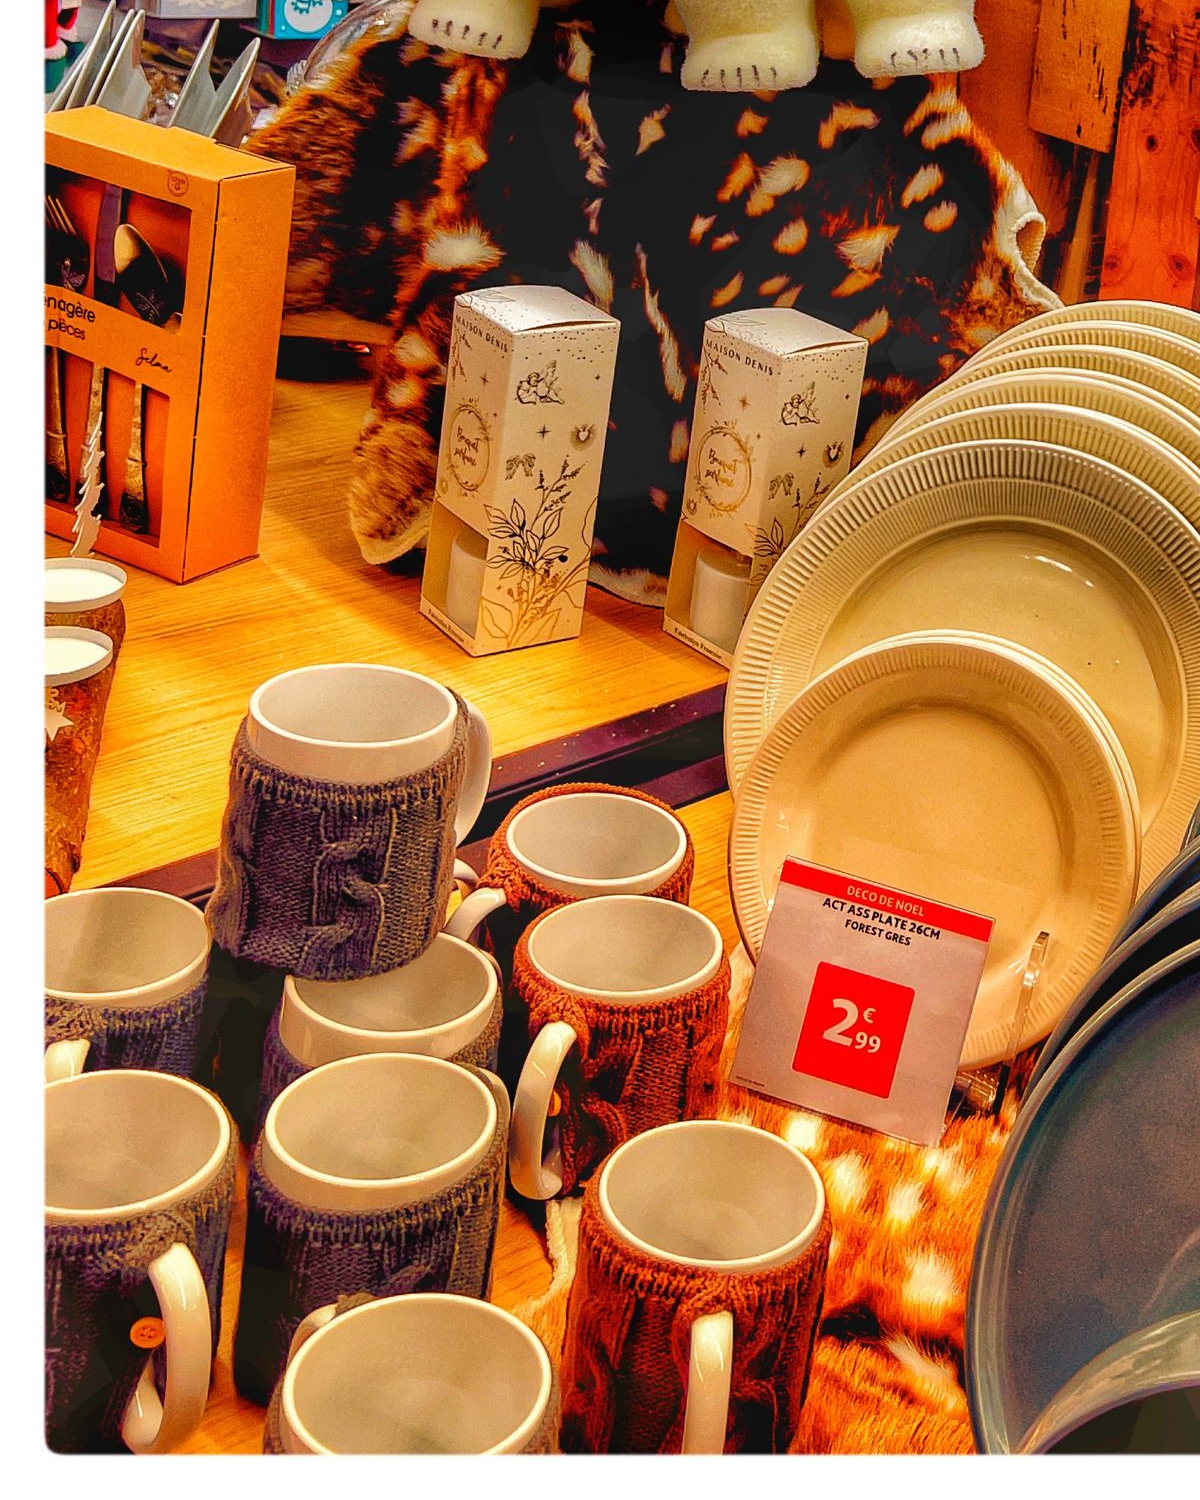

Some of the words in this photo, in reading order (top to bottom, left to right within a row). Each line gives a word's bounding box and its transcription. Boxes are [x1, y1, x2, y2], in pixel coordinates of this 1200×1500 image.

[44, 296, 96, 323] nagère
[455, 314, 483, 339] MAISON
[485, 332, 508, 354] DENIS
[706, 338, 741, 362] MAISON
[744, 355, 774, 376] DENIS
[822, 896, 847, 914] ACT
[847, 905, 870, 919] ASS
[872, 910, 908, 931] PLATE
[908, 921, 941, 941] 26CM
[847, 885, 878, 903] DECO
[879, 893, 894, 909] DE
[895, 897, 926, 918] NOEL
[844, 918, 885, 939] FOREST
[885, 930, 912, 947] GRES
